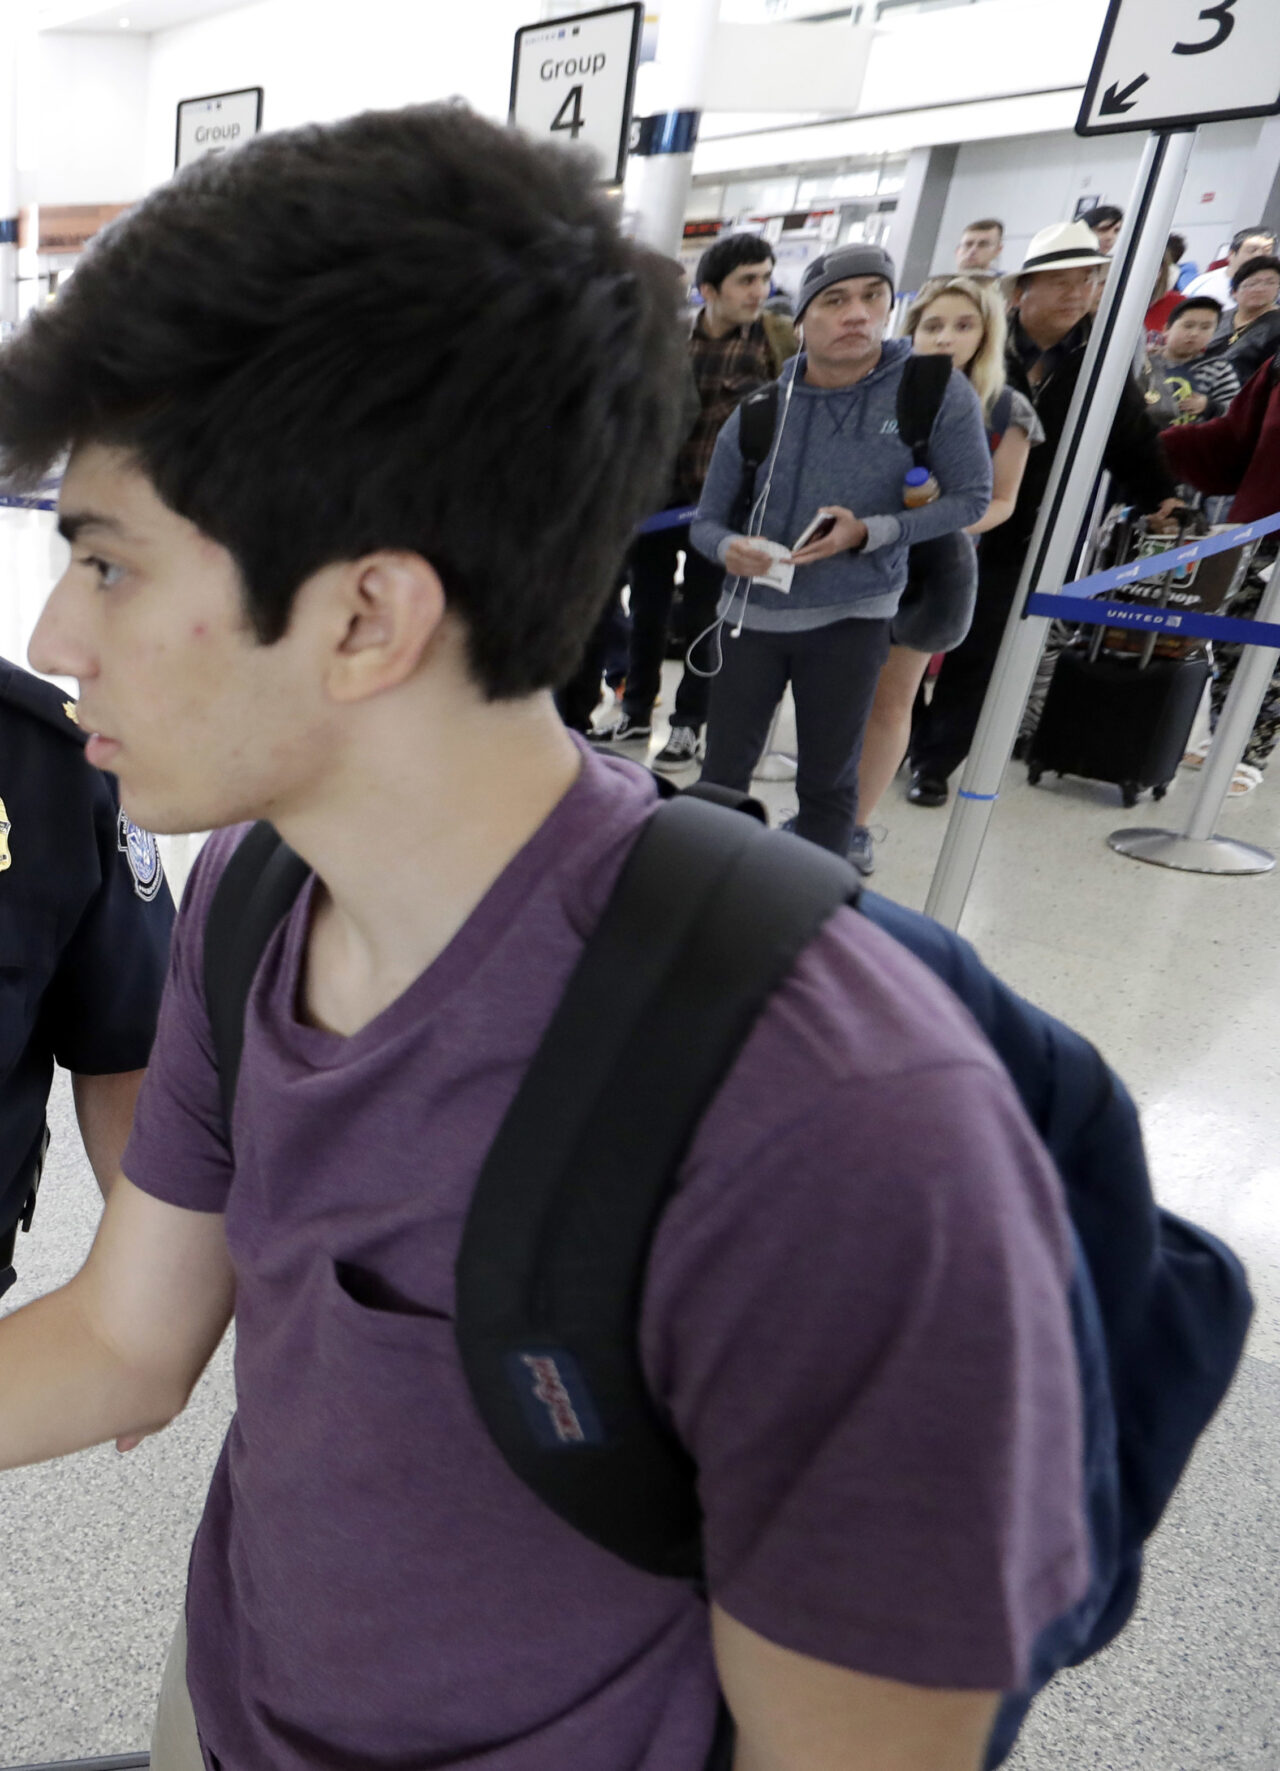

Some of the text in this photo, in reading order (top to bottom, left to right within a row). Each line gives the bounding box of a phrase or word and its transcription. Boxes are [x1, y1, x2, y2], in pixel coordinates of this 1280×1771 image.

[1171, 0, 1236, 55] 3
[540, 52, 607, 82] Group
[550, 84, 585, 139] 4
[195, 122, 241, 142] Group
[1106, 609, 1164, 624] UNITED
